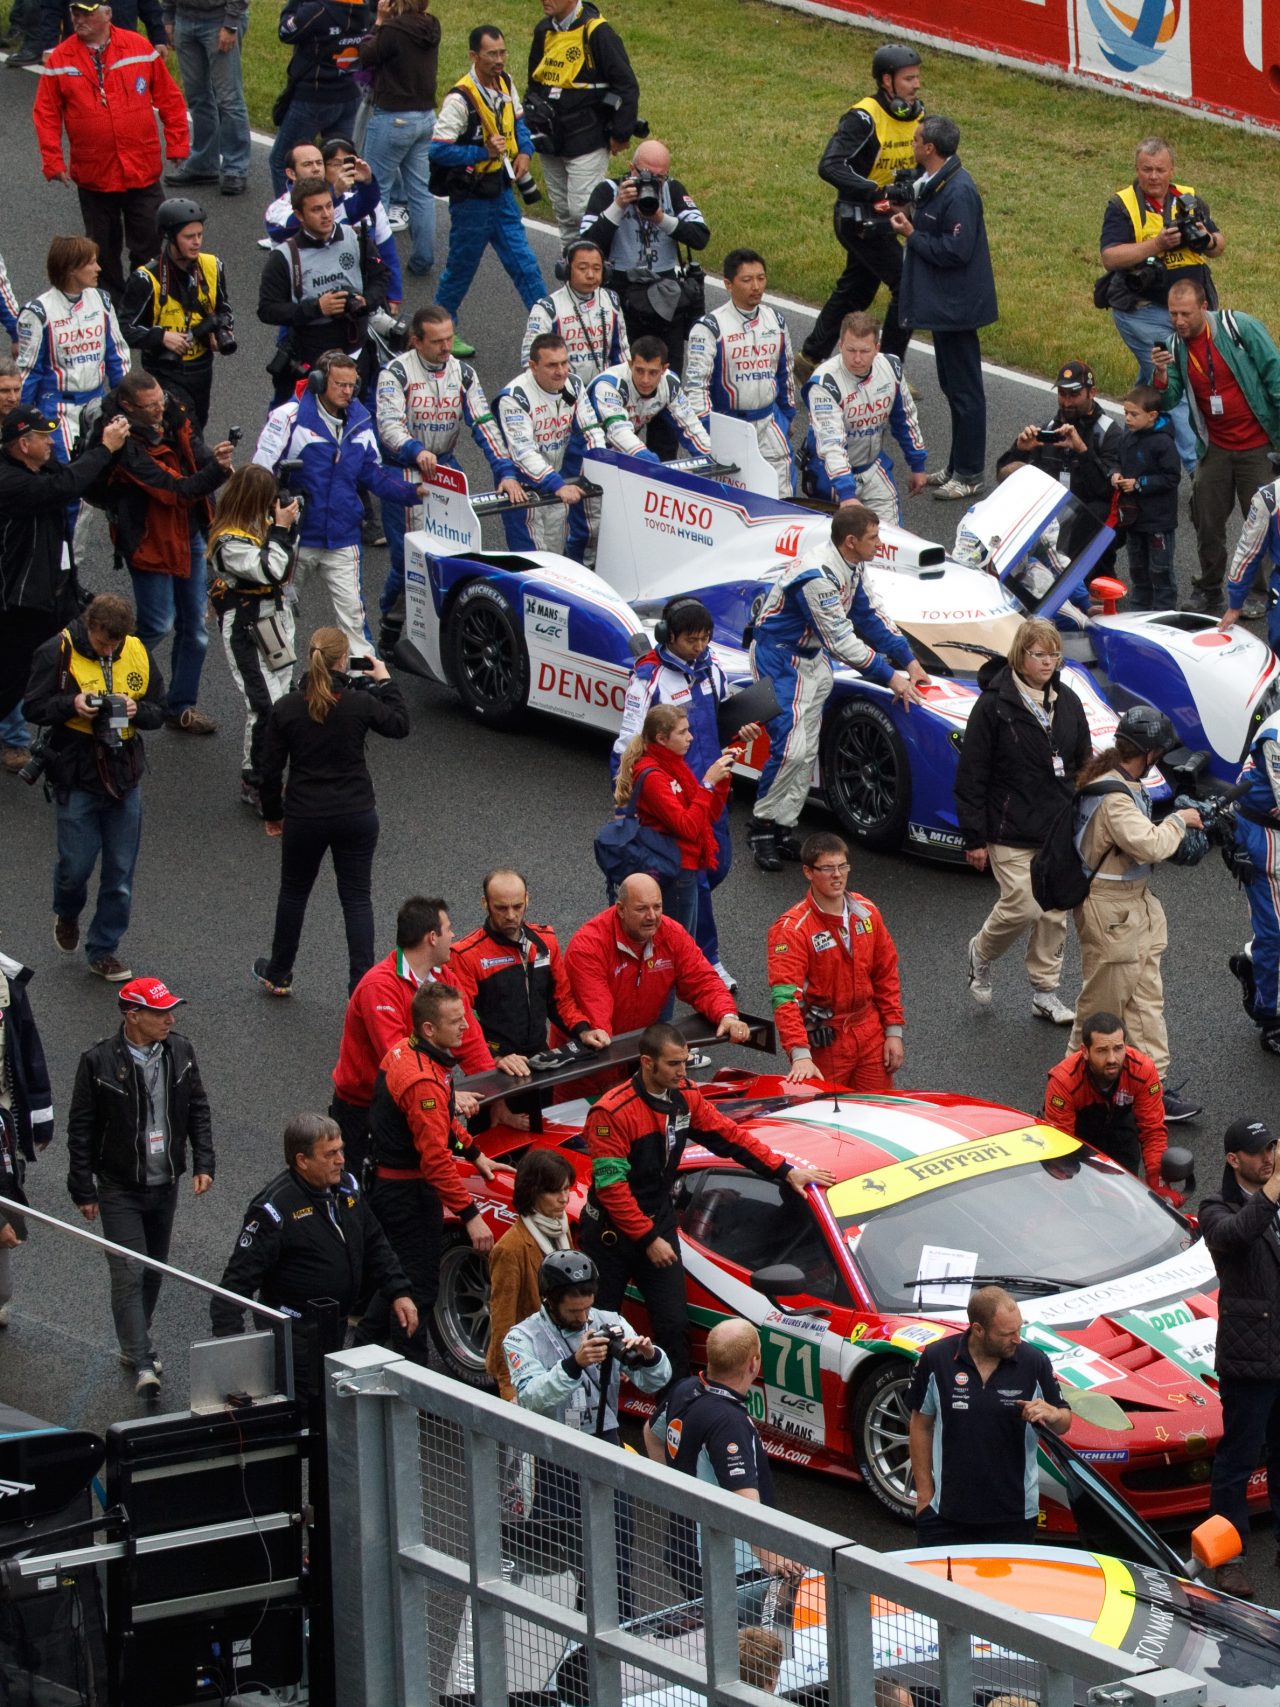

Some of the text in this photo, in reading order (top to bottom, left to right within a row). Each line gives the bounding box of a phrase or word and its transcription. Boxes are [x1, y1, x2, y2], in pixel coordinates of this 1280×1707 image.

[1161, 252, 1186, 265] EDIA
[312, 271, 344, 288] Nikon
[58, 324, 103, 345] DENSO
[727, 333, 746, 342] ZENT
[63, 341, 101, 356] TOYOTA
[731, 343, 777, 359] DENSO
[64, 352, 101, 365] HYBRID
[411, 396, 460, 409] DENSO
[847, 396, 891, 418] DENSO
[415, 411, 457, 421] TOYOTA
[849, 413, 889, 429] TOYOTA
[412, 423, 455, 432] HYBRID
[715, 475, 747, 490] DENSO
[644, 490, 713, 531] DENSO
[425, 516, 472, 547] Matmut
[644, 517, 714, 547] TOYOTA HYBRID
[875, 544, 898, 561] ENT
[468, 584, 509, 609] MICHELIN
[537, 604, 559, 621] MANS
[921, 609, 986, 621] TOYOTA
[536, 623, 562, 638] WEC
[538, 662, 626, 712] DENSO
[852, 702, 896, 735] MICHELIN
[905, 1143, 1011, 1181] Ferrari
[1040, 1285, 1126, 1320] AUCTION
[1146, 1264, 1212, 1285] EMILIA
[767, 1311, 826, 1333] 24 HEURES DU MANS
[1150, 1309, 1190, 1332] PRO
[769, 1331, 815, 1398] 71
[745, 1390, 764, 1420] RO
[781, 1395, 816, 1413] WEC
[785, 1421, 813, 1441] MANS
